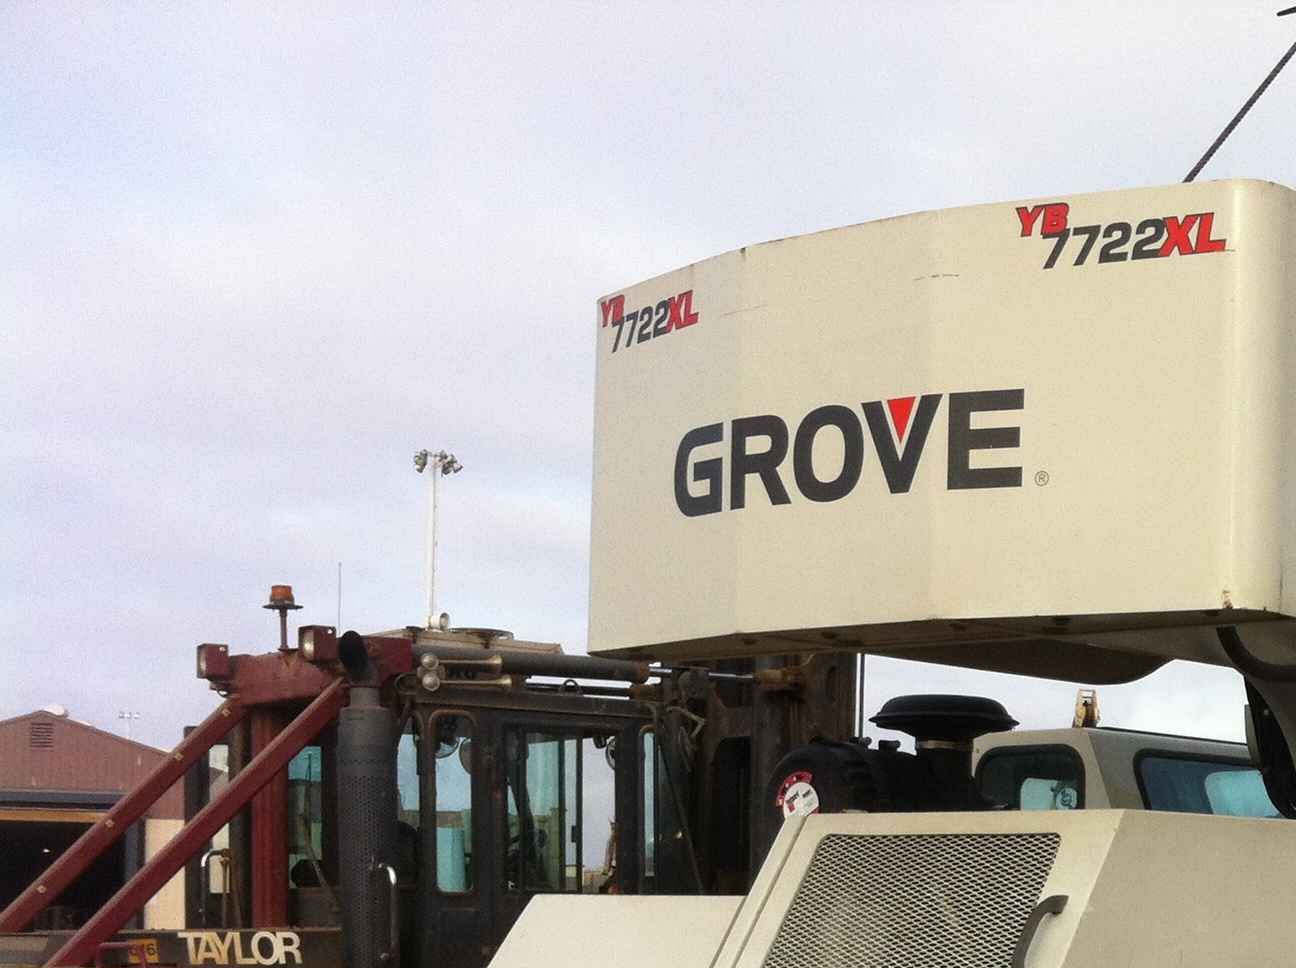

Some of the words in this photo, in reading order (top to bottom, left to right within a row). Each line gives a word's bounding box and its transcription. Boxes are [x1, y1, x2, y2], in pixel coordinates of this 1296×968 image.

[1016, 202, 1070, 238] YB
[1042, 212, 1226, 269] 7722XL
[601, 294, 625, 328] YB
[612, 289, 699, 353] 7722XL
[674, 388, 1025, 518] GROVE
[177, 931, 303, 966] TAYLOR
